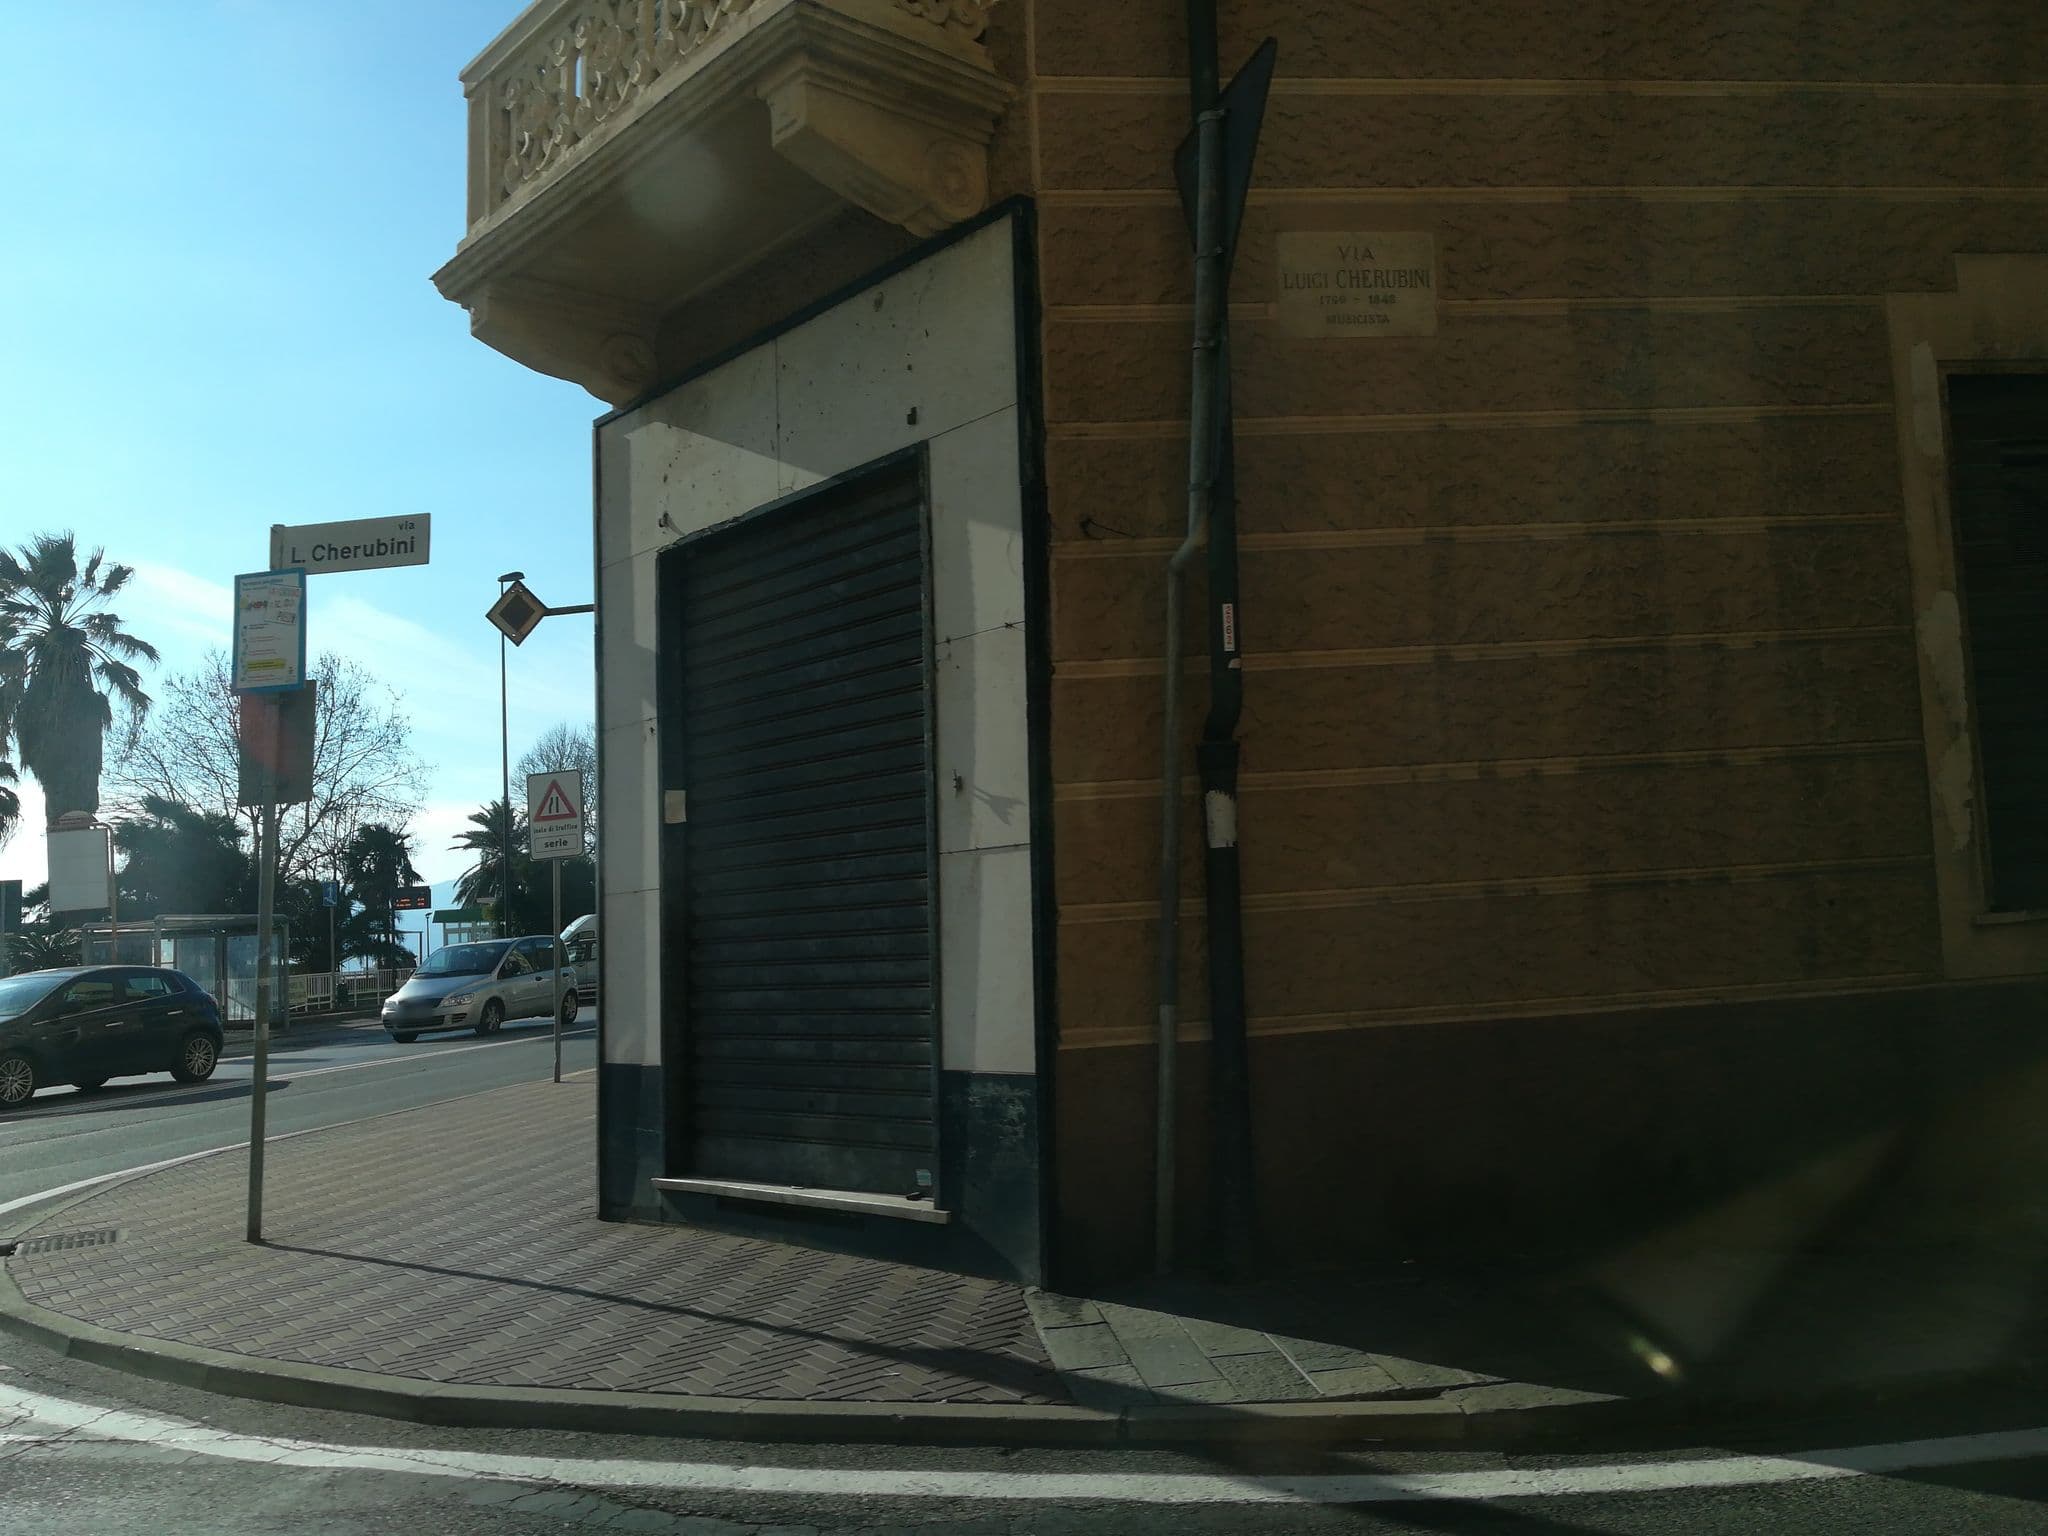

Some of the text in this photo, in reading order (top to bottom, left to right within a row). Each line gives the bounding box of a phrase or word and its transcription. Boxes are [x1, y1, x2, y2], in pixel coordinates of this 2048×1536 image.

[1336, 246, 1376, 261] VIA
[1283, 268, 1431, 289] LUIGI CHERUBINI
[1325, 313, 1391, 325] MUSICISTA
[398, 520, 415, 530] via
[291, 536, 415, 563] L. Cherubini
[555, 823, 577, 831] traffico
[544, 838, 568, 848] serie
